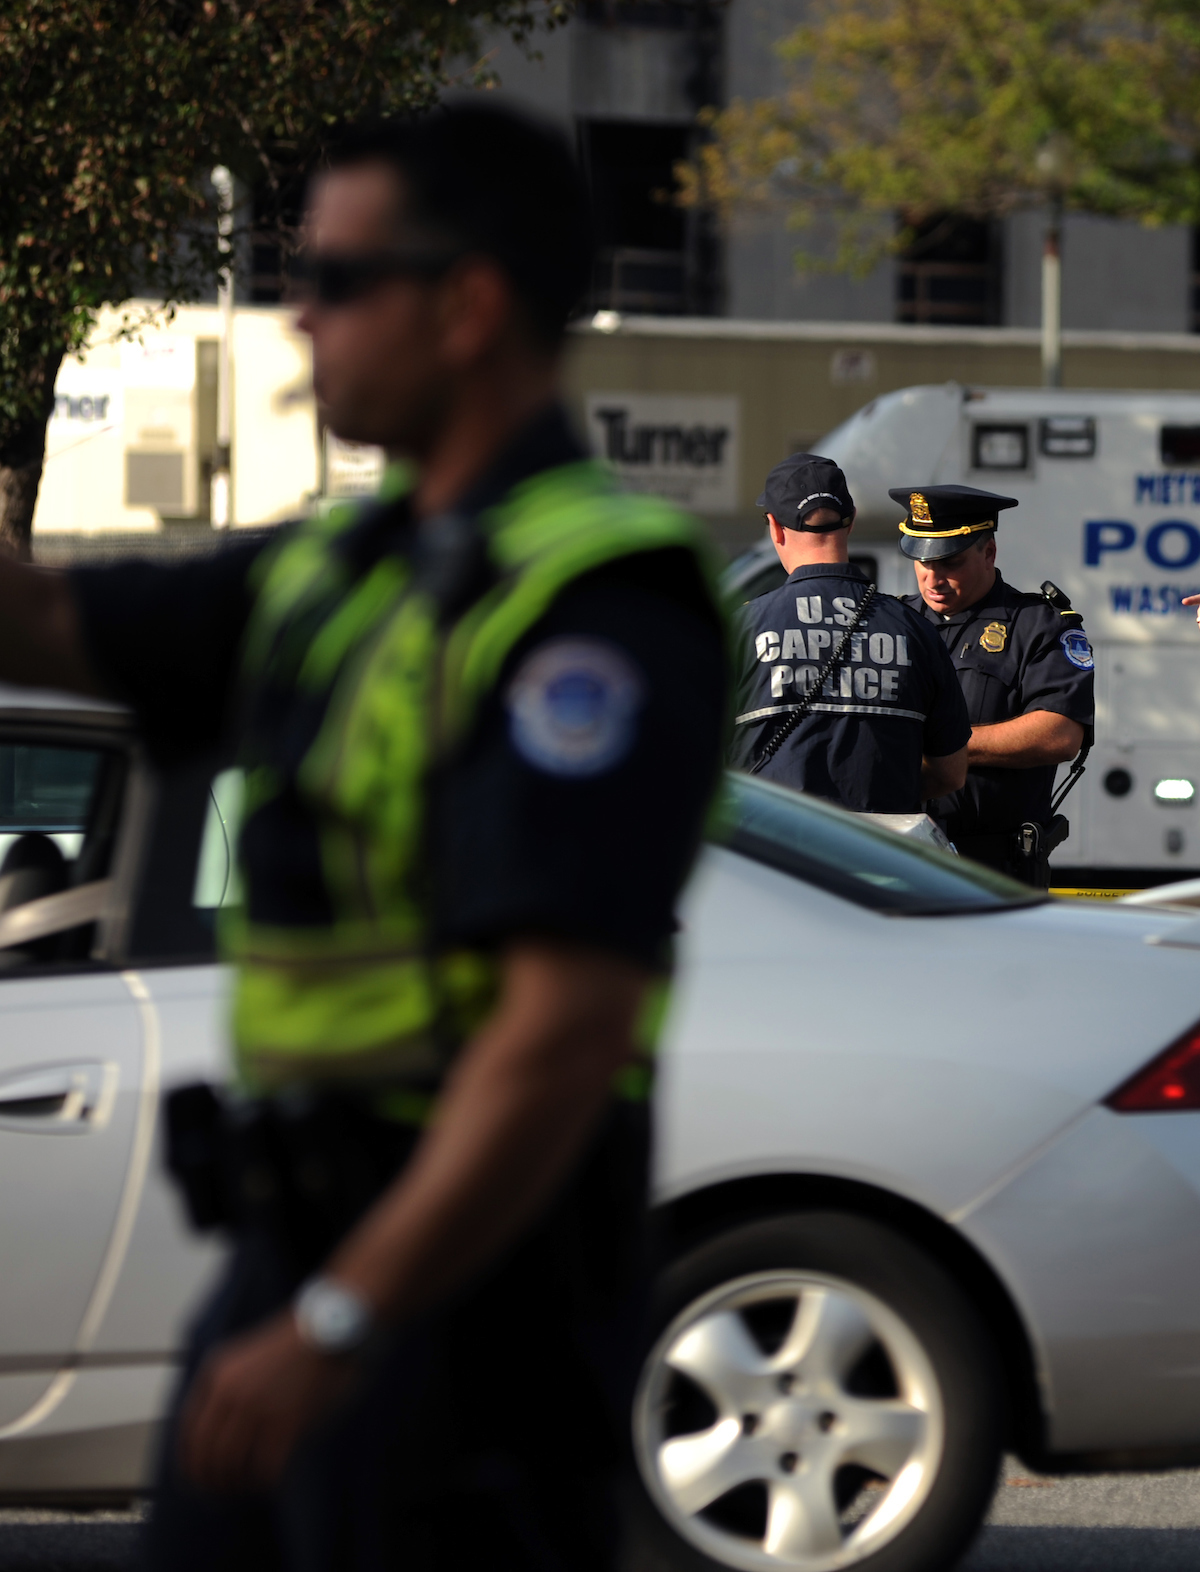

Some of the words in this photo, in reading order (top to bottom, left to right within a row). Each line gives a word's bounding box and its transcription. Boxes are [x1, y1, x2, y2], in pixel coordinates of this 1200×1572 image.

[54, 393, 110, 421] rner
[595, 408, 729, 468] Turner
[770, 664, 899, 701] POLICE
